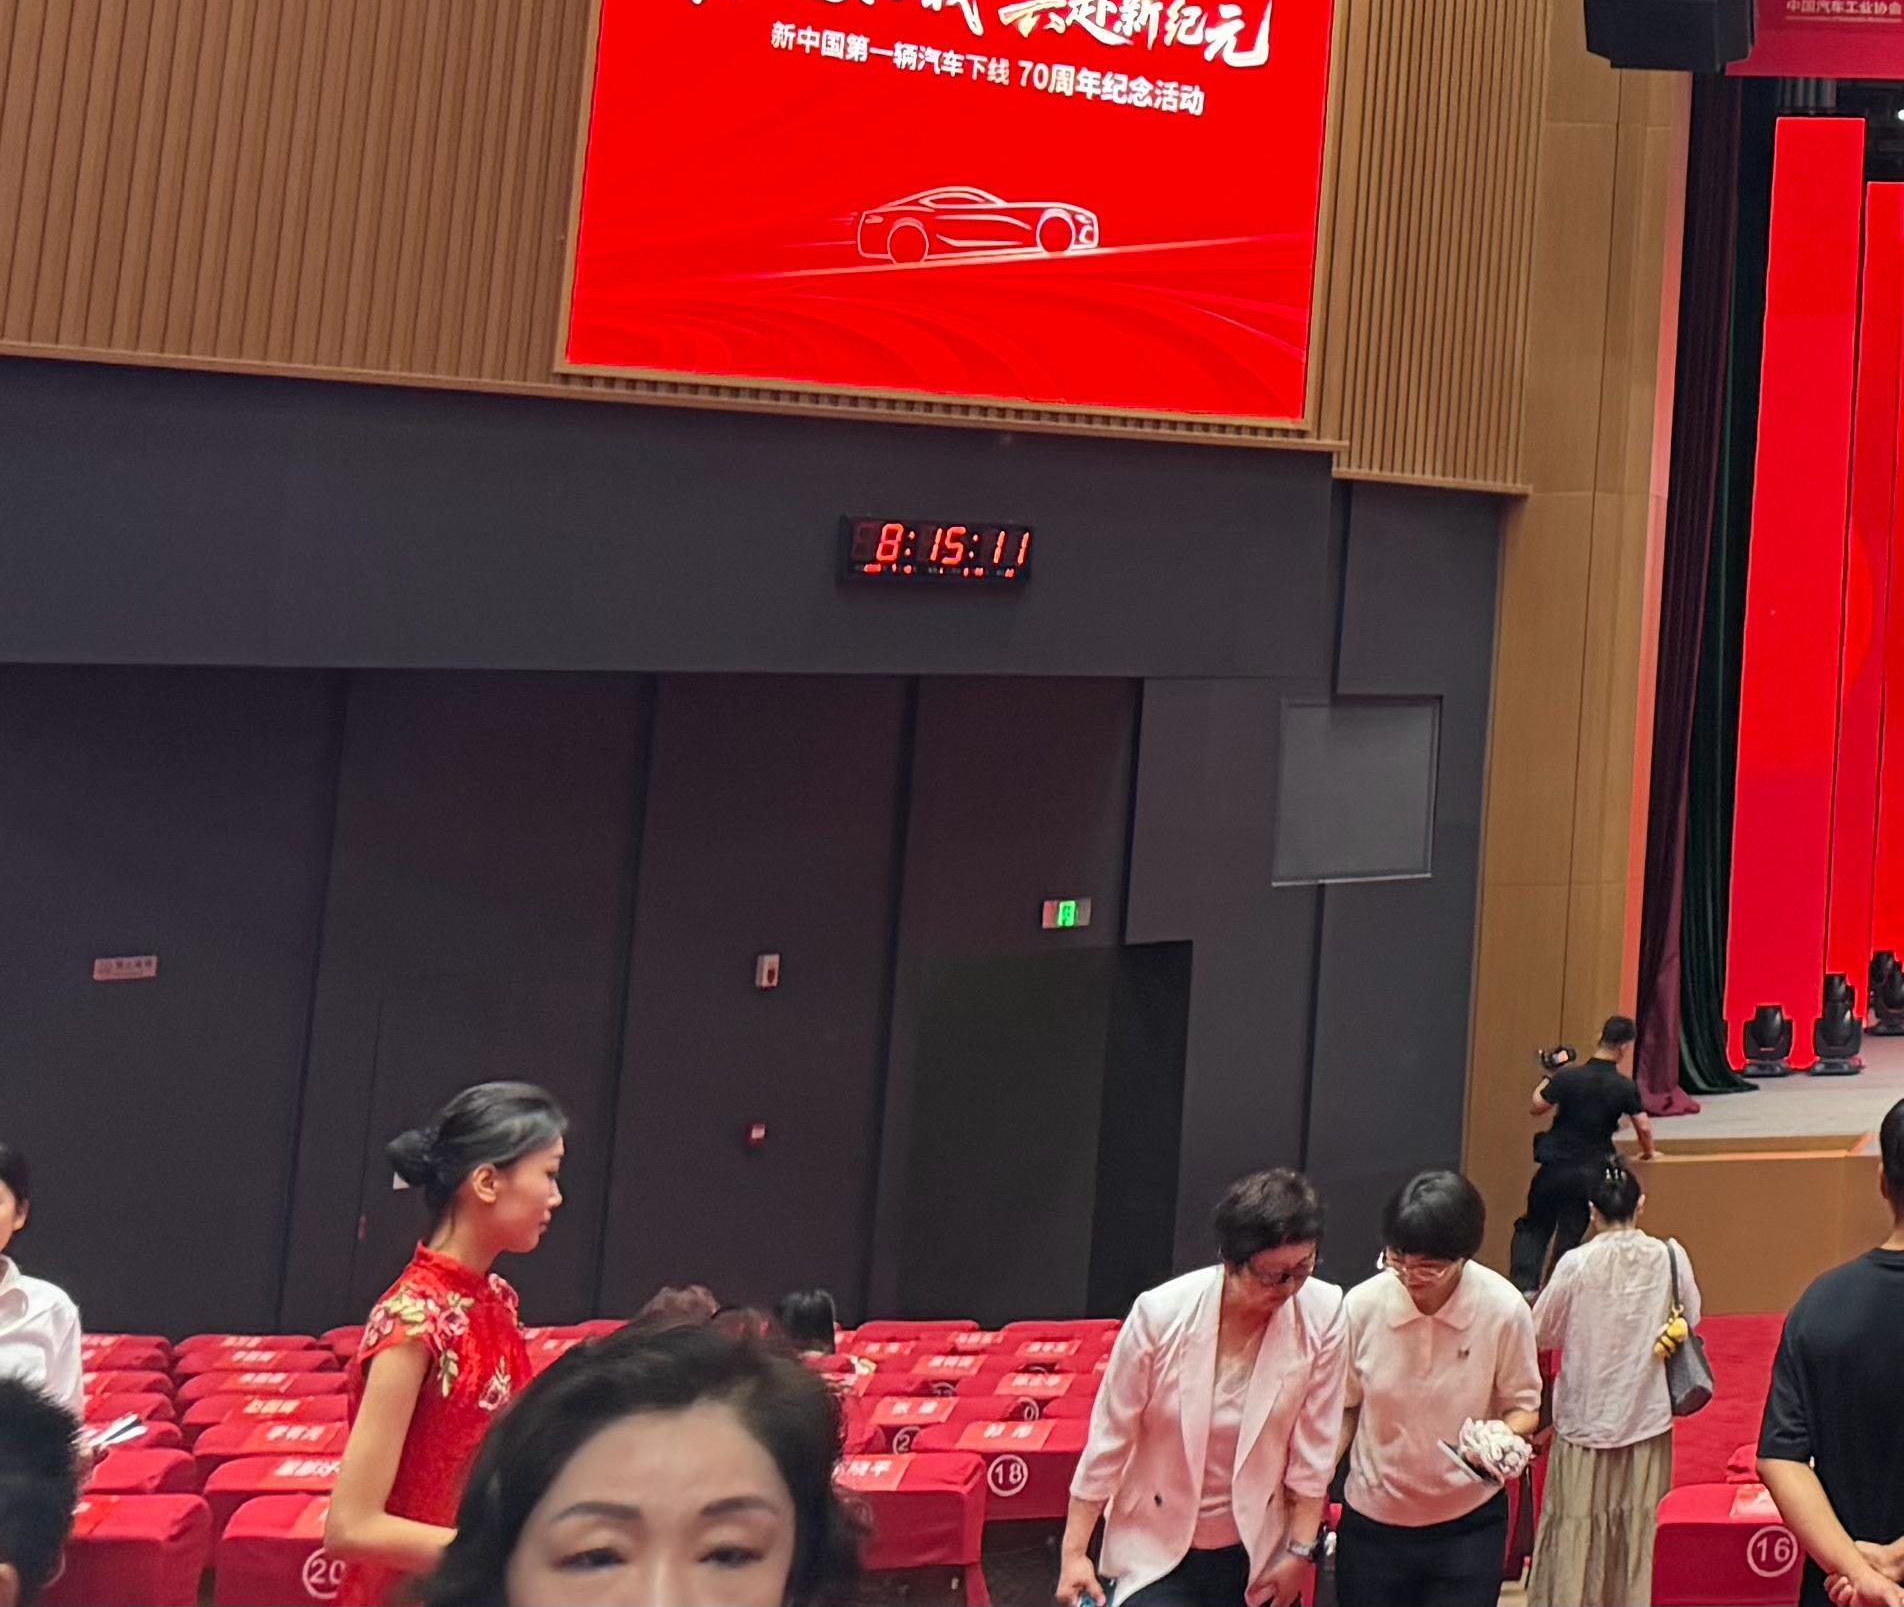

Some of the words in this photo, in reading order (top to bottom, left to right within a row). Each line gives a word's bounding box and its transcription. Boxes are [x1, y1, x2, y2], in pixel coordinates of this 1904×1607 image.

[771, 21, 1009, 85] 新中国第一辆汽车下线
[1019, 61, 1204, 115] 70周年纪念活动
[875, 523, 1030, 566] 8:15:11
